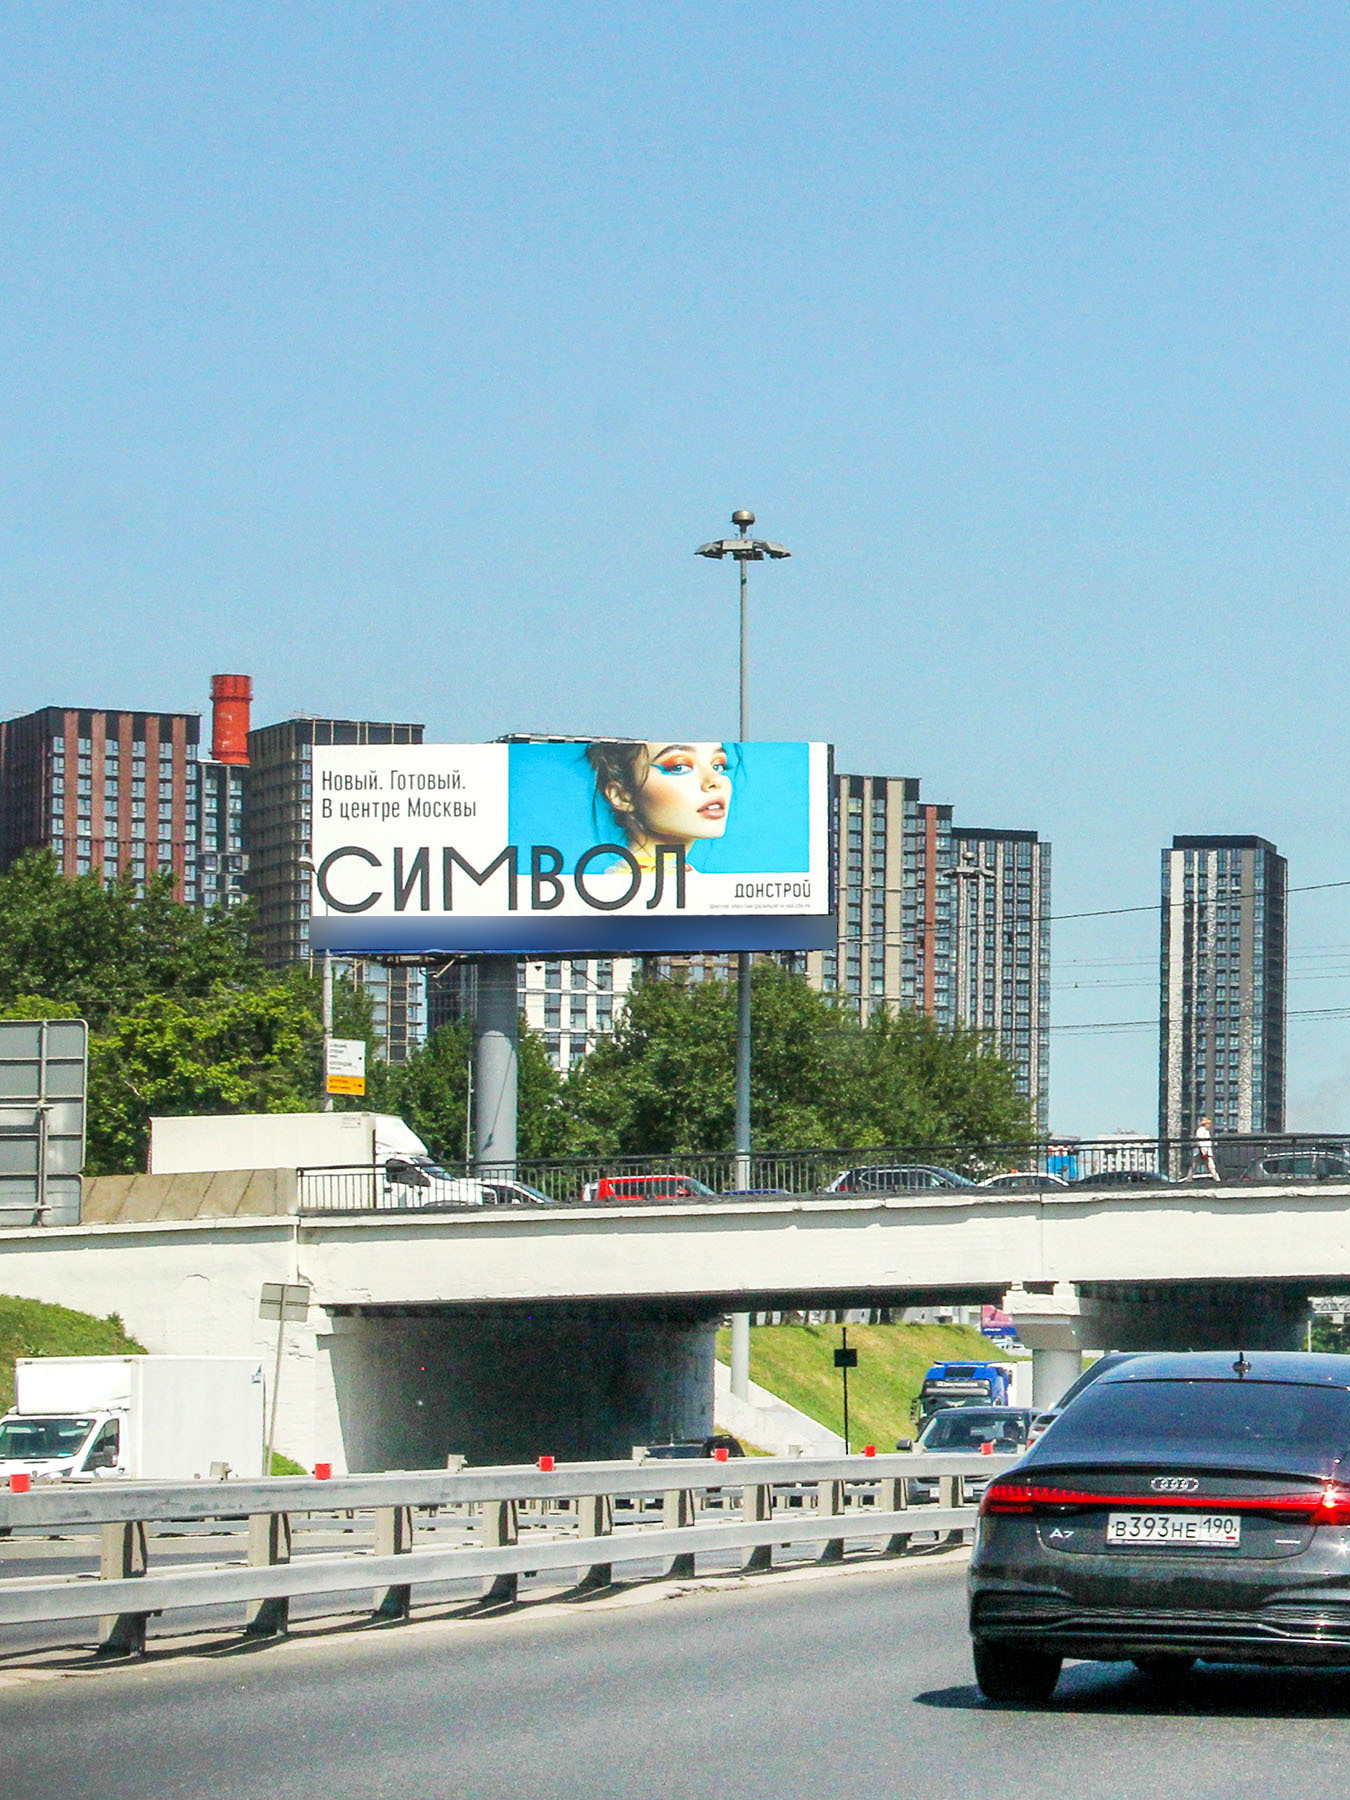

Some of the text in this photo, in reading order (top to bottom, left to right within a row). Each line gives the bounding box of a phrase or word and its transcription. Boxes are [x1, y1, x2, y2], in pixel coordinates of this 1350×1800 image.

[322, 769, 466, 791] Новый. Готовый.
[322, 797, 476, 822] В центре Москвы
[317, 843, 686, 913] СИМВОЛ
[734, 879, 811, 898] ДОНСТРОЙ
[1049, 1528, 1074, 1538] A7
[1115, 1516, 1234, 1538] В393НЕ 190
